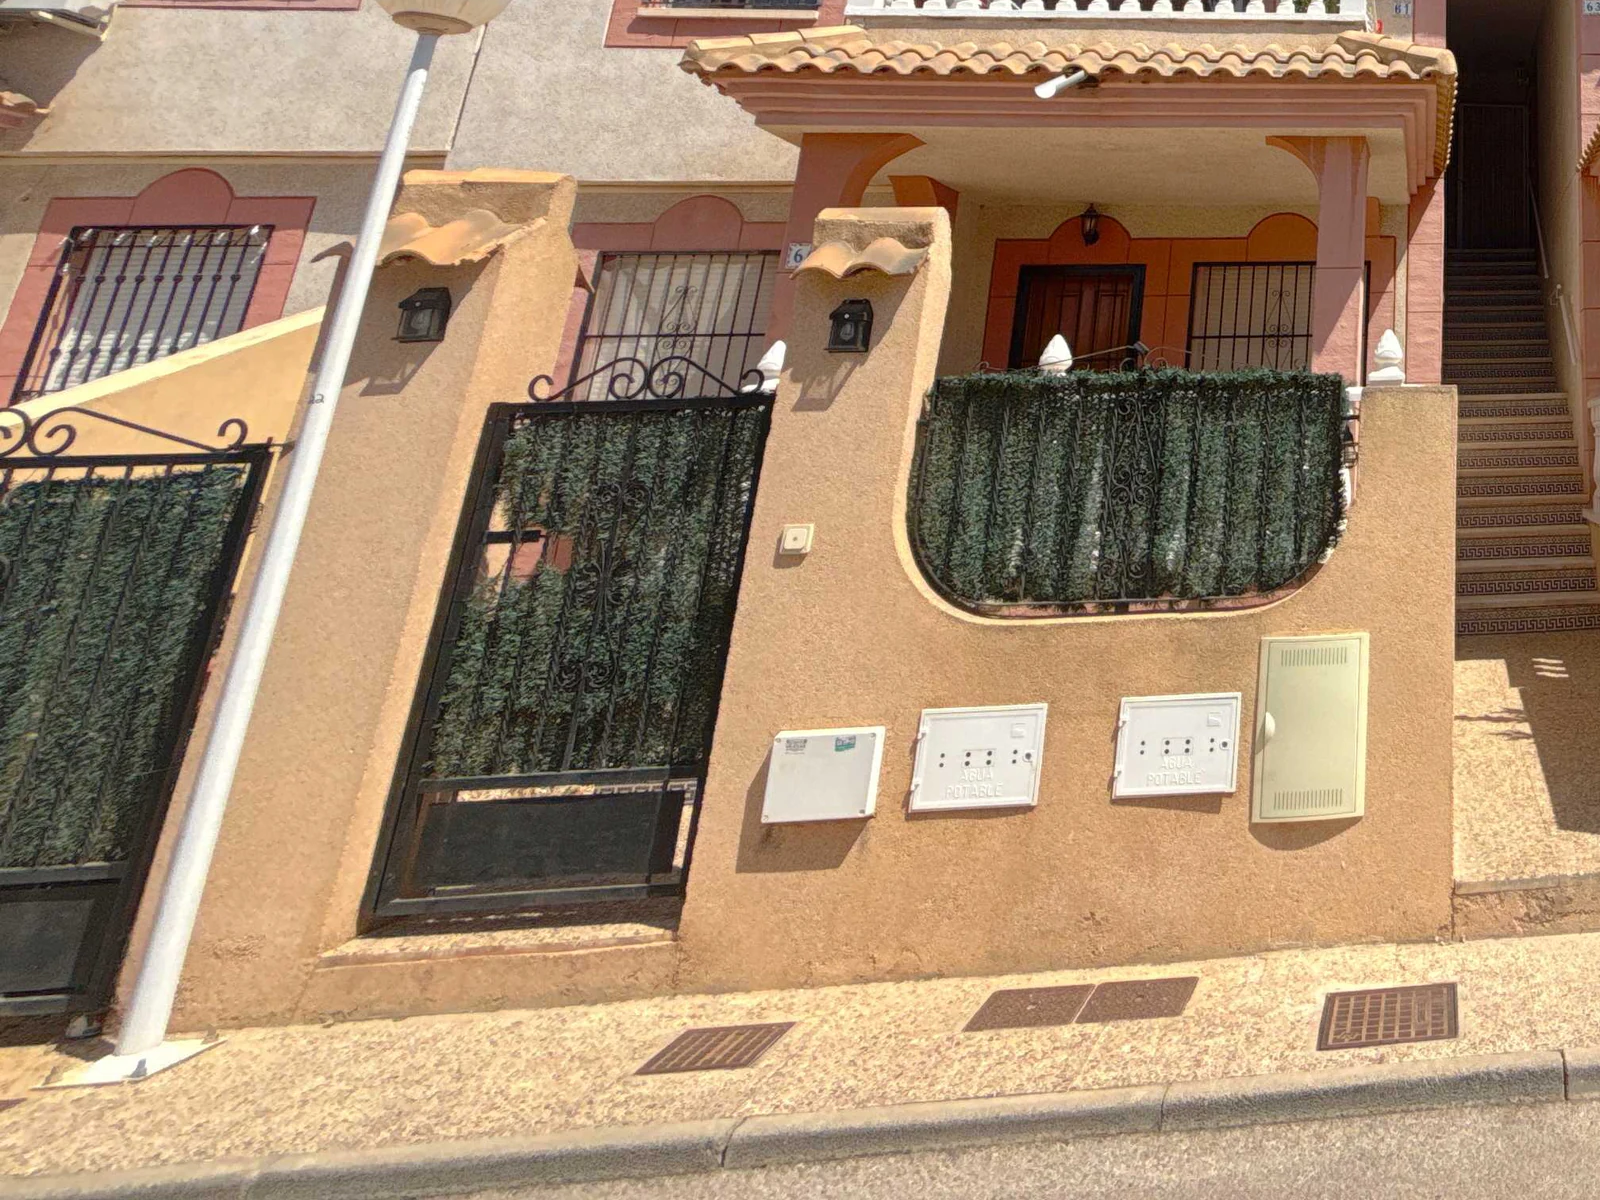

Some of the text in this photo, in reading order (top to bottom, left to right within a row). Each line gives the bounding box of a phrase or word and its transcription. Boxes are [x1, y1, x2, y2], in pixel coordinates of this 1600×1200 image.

[1394, 3, 1409, 15] 61
[1586, 1, 1600, 12] 63
[1160, 754, 1194, 769] AGUA
[961, 766, 994, 782] AGUA
[1145, 769, 1202, 787] POTABLE
[945, 781, 1004, 799] POTABLE
